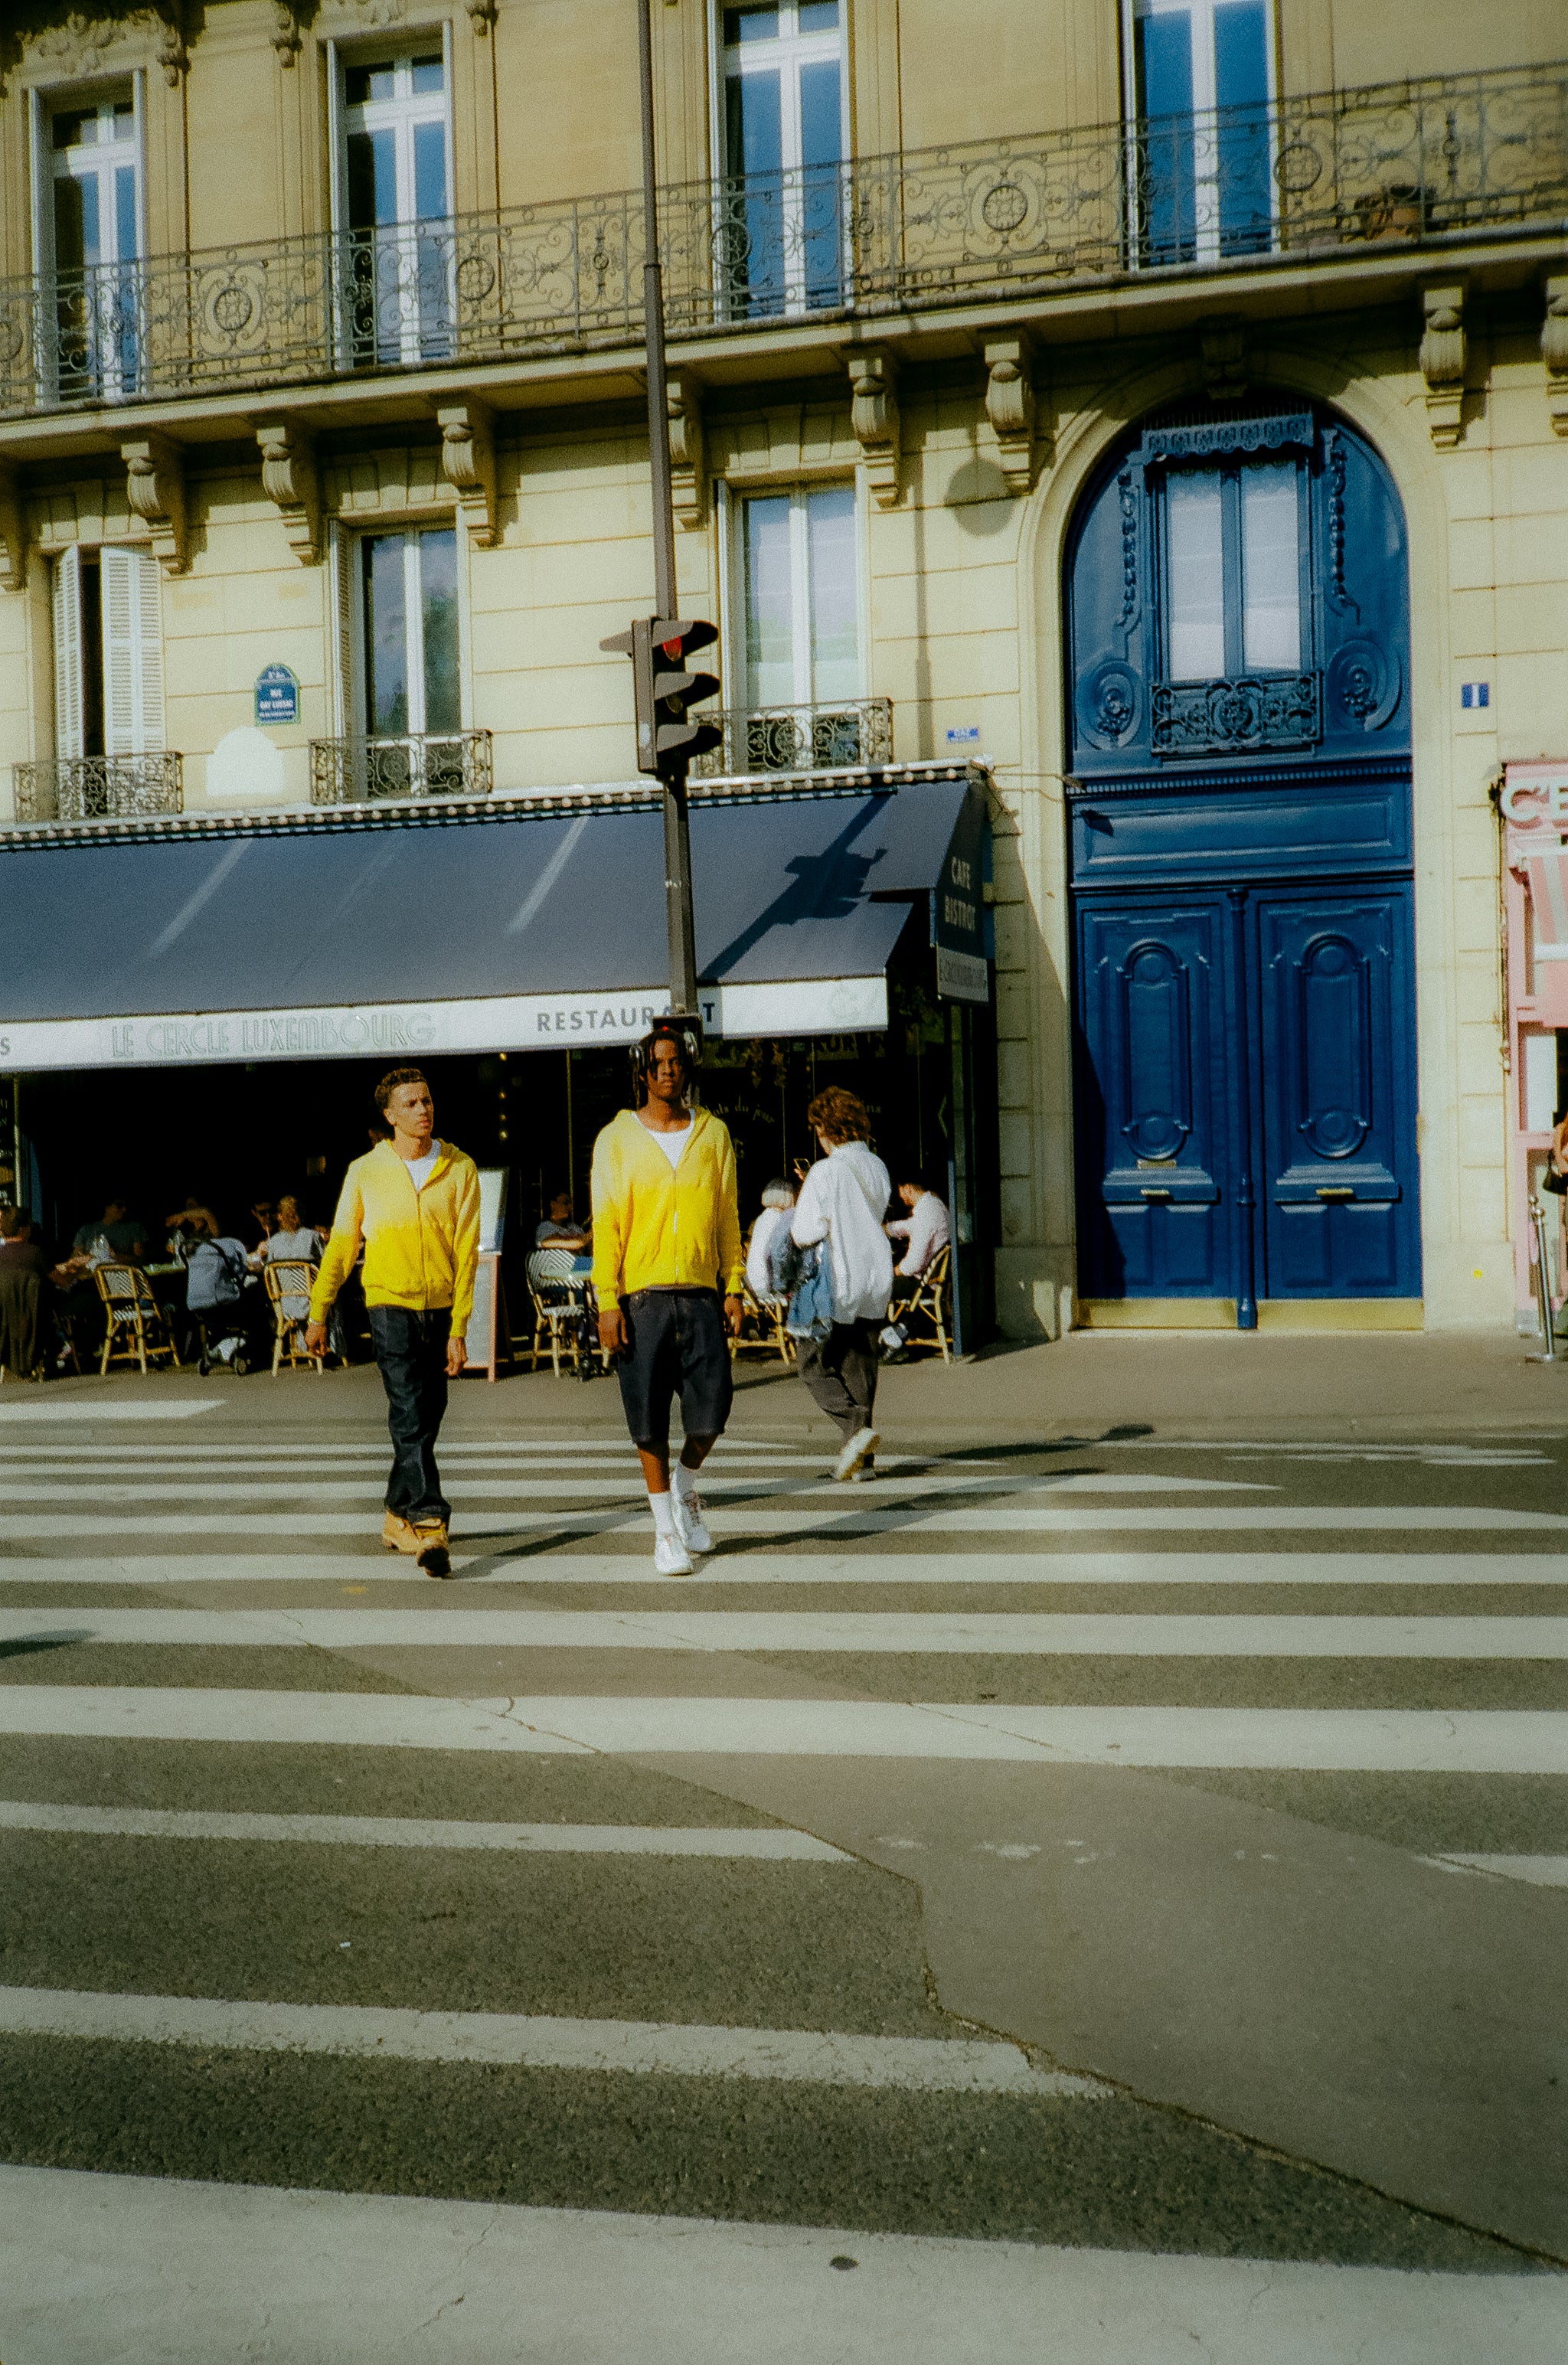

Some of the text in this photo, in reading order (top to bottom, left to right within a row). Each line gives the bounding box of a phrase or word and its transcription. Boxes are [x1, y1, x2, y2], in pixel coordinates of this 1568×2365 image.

[1470, 684, 1480, 708] 1
[113, 1013, 437, 1057] LE CERCLE LUXEMBOURG
